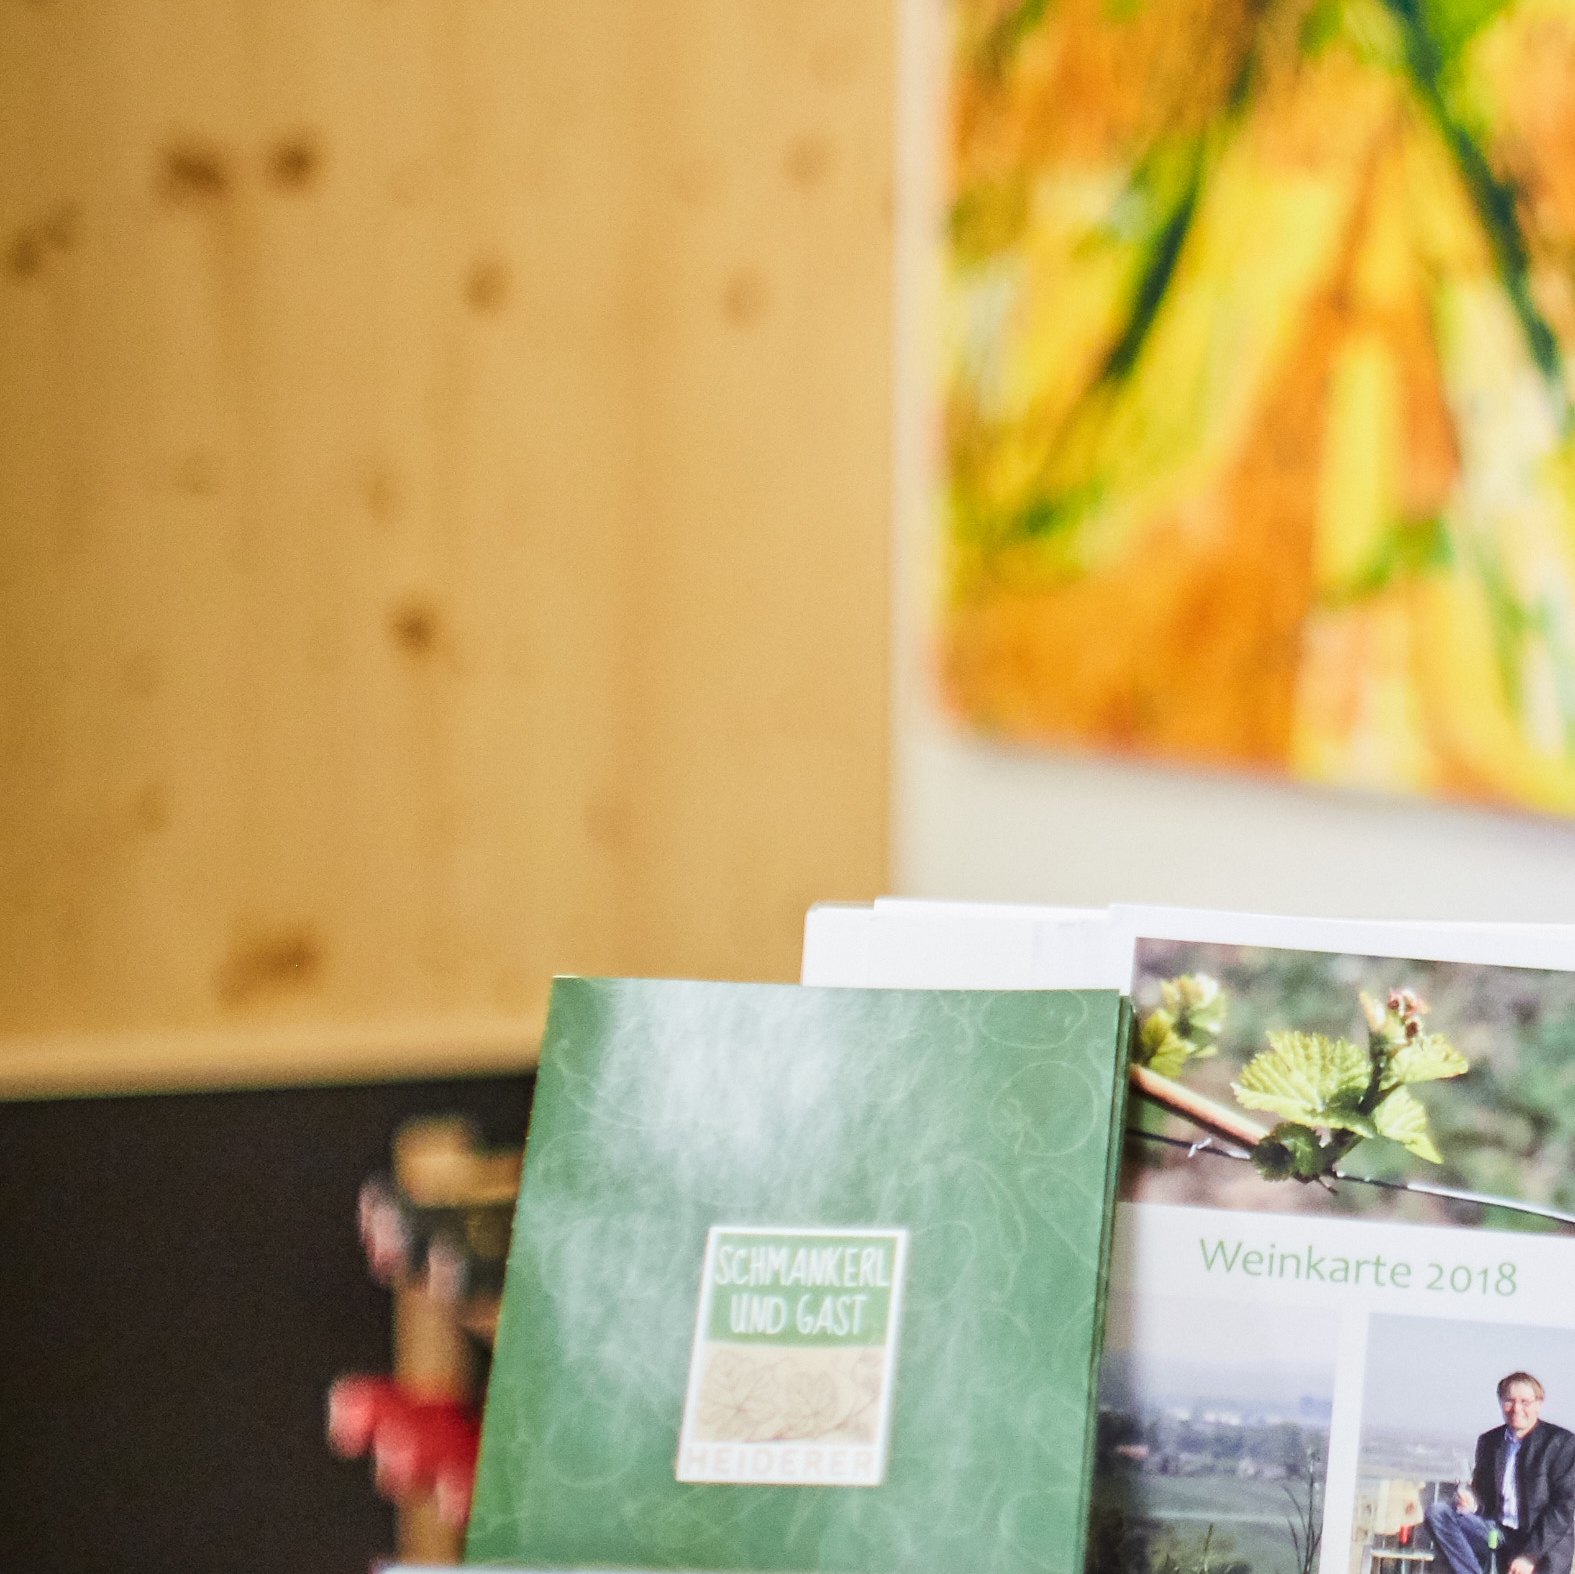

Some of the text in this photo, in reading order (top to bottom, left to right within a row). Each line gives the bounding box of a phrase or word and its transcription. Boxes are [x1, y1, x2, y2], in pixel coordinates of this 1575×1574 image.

[714, 1244, 890, 1288] SCHMANKERL
[1200, 1237, 1518, 1297] Weinkarte 2018
[730, 1292, 868, 1336] UND GAST
